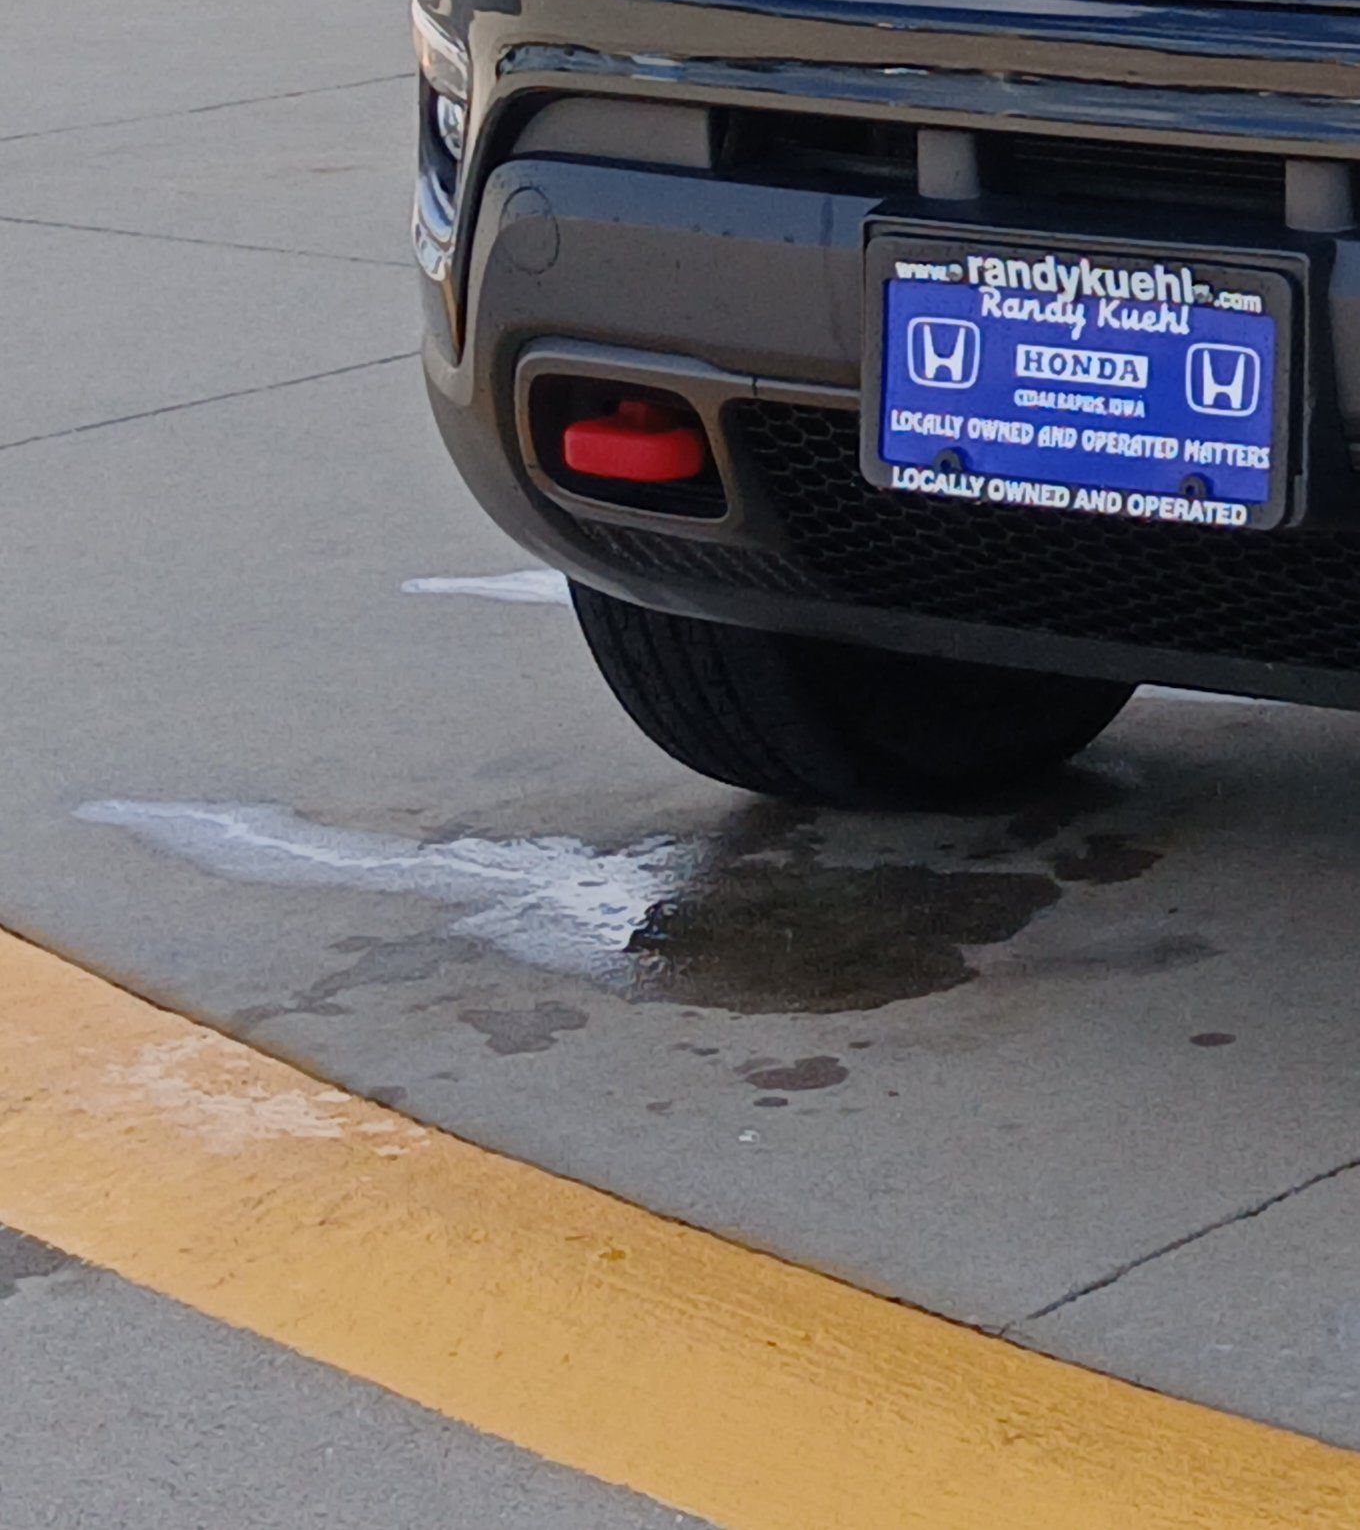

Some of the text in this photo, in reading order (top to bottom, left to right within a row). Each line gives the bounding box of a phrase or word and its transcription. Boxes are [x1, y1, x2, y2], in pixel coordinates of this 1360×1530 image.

[978, 286, 1190, 341] Randy Kuehl
[1023, 350, 1140, 382] HONDA
[891, 409, 1271, 469] LOCALLY OWNED AND OPERATED MATTERS
[892, 466, 1248, 526] LOCALLY OWNED AND OPERATED
